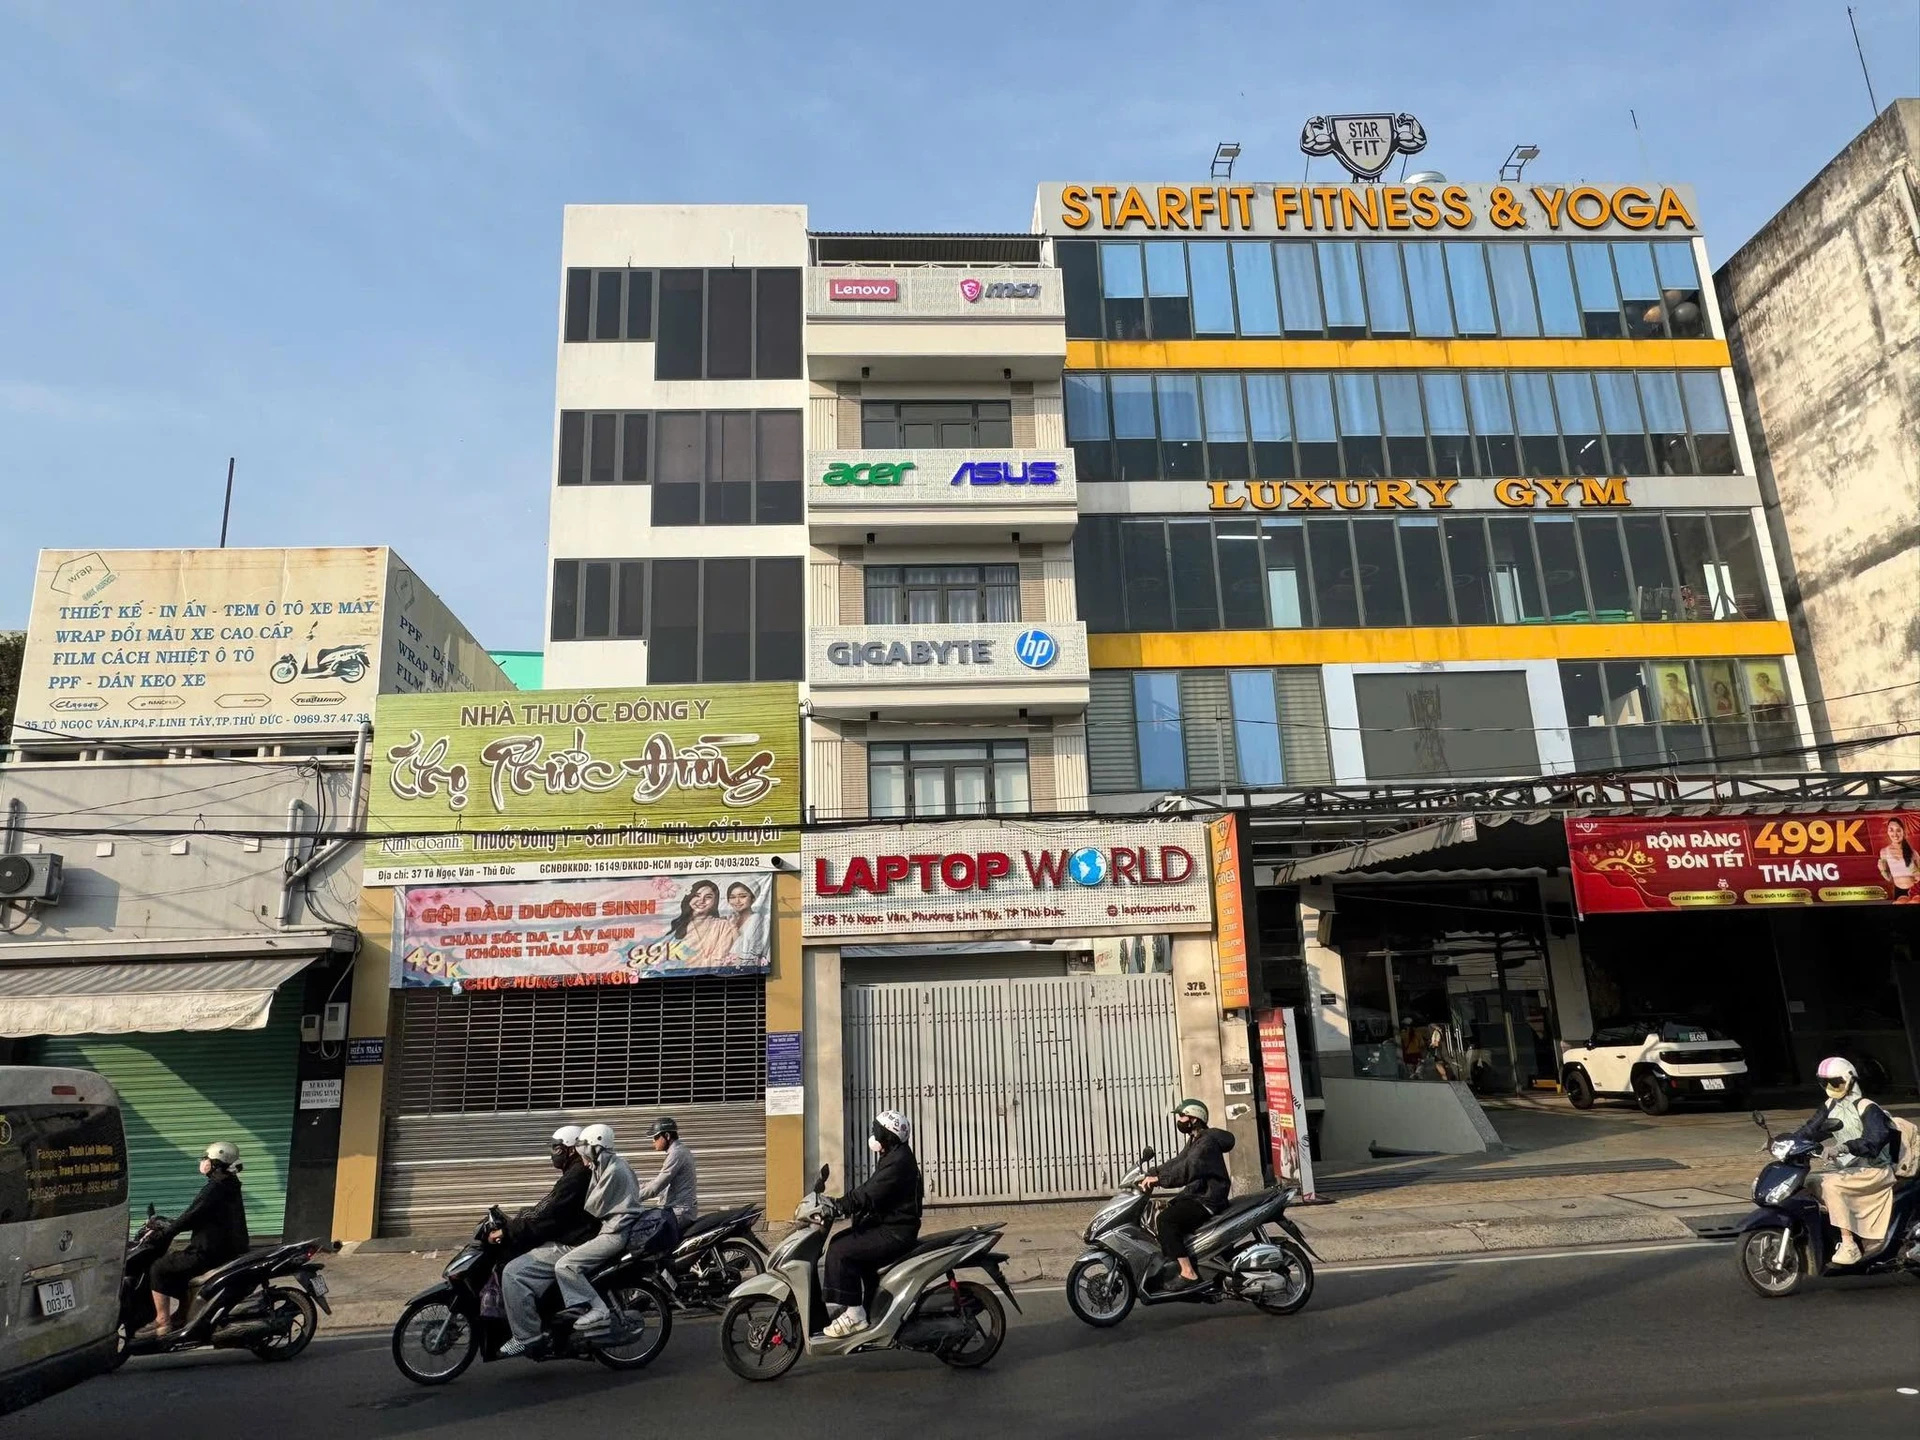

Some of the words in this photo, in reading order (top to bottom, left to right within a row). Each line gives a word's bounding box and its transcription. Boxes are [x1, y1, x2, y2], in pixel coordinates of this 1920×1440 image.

[1348, 122, 1380, 138] STAR
[1352, 140, 1380, 156] FIT
[1061, 186, 1254, 230] STARFIT
[1273, 186, 1474, 230] FITNESS
[1490, 186, 1526, 229] &
[1530, 186, 1696, 229] YOGA
[834, 283, 890, 294] Lenovo
[985, 282, 1040, 298] msi
[822, 462, 916, 486] acer
[951, 462, 1058, 486] ASUS
[1207, 479, 1460, 510] LUXURY
[1494, 477, 1632, 507] GYM
[68, 564, 93, 583] wrap
[60, 600, 113, 619] THIẾT
[118, 600, 144, 618] KẾ
[159, 605, 177, 617] IN
[182, 599, 206, 617] ẤN
[224, 604, 260, 617] TEM
[266, 601, 276, 615] Ô
[283, 600, 304, 615] TÔ
[310, 602, 332, 615] XE
[338, 598, 375, 614] MÁY
[55, 630, 106, 643] WRAP
[110, 622, 142, 642] ĐỔI
[148, 626, 185, 641] MÀU
[191, 628, 215, 640] XE
[220, 627, 253, 640] CAO
[260, 621, 293, 639] CẤP
[400, 615, 422, 642] PPF
[53, 652, 96, 665] FILM
[102, 648, 150, 664] CÁCH
[156, 647, 210, 666] NHIỆT
[216, 647, 226, 662] Ô
[234, 646, 254, 662] TÔ
[398, 639, 428, 673] WRAP
[827, 640, 992, 668] GIGABYTE
[1021, 630, 1050, 667] hp
[48, 676, 81, 689] PPF
[98, 672, 135, 688] DÁN
[140, 674, 176, 688] KEO
[182, 674, 206, 687] XE
[460, 700, 516, 726] NHÀ
[522, 695, 608, 725] THUỐC
[614, 697, 689, 722] ĐÔNG
[692, 700, 711, 720] Y
[24, 720, 38, 730] 35
[42, 719, 56, 730] TÔ
[61, 718, 93, 731] NGỌC
[260, 714, 283, 725] ĐỨC
[1646, 831, 1686, 851] RỘN
[1690, 830, 1741, 847] RÀNG
[1754, 820, 1866, 855] 499K
[674, 859, 692, 870] ngày
[714, 857, 760, 868] 04/03/2025
[1667, 850, 1708, 869] ĐÓN
[1712, 849, 1744, 868] TẾT
[378, 871, 392, 881] Địa
[411, 869, 422, 878] 37
[436, 868, 457, 879] Ngọc
[458, 867, 474, 877] Vân
[483, 864, 498, 876] Thủ
[500, 864, 516, 875] Đức
[816, 852, 1010, 896] LAPTOP
[1022, 845, 1194, 888] WORLD
[1758, 860, 1839, 883] THÁNG
[422, 904, 461, 926] GỘI
[465, 900, 512, 922] ĐẦU
[519, 899, 596, 919] DƯỠNG
[602, 900, 656, 916] SINH
[857, 913, 883, 925] Ngọc
[912, 911, 954, 924] Phường
[956, 910, 978, 921] Linh
[1004, 908, 1019, 918] TP
[1021, 907, 1040, 918] Thủ
[1043, 906, 1066, 918] Đức
[1122, 904, 1196, 917] laptopworld.vn
[440, 932, 487, 946] CHĂM
[491, 930, 522, 944] SÓC
[526, 931, 548, 942] DA
[562, 925, 594, 941] LẤY
[598, 927, 635, 941] MỤN
[406, 946, 463, 978] 49K
[466, 946, 522, 959] KHÔNG
[528, 944, 574, 957] THÂM
[1187, 981, 1207, 991] 37B
